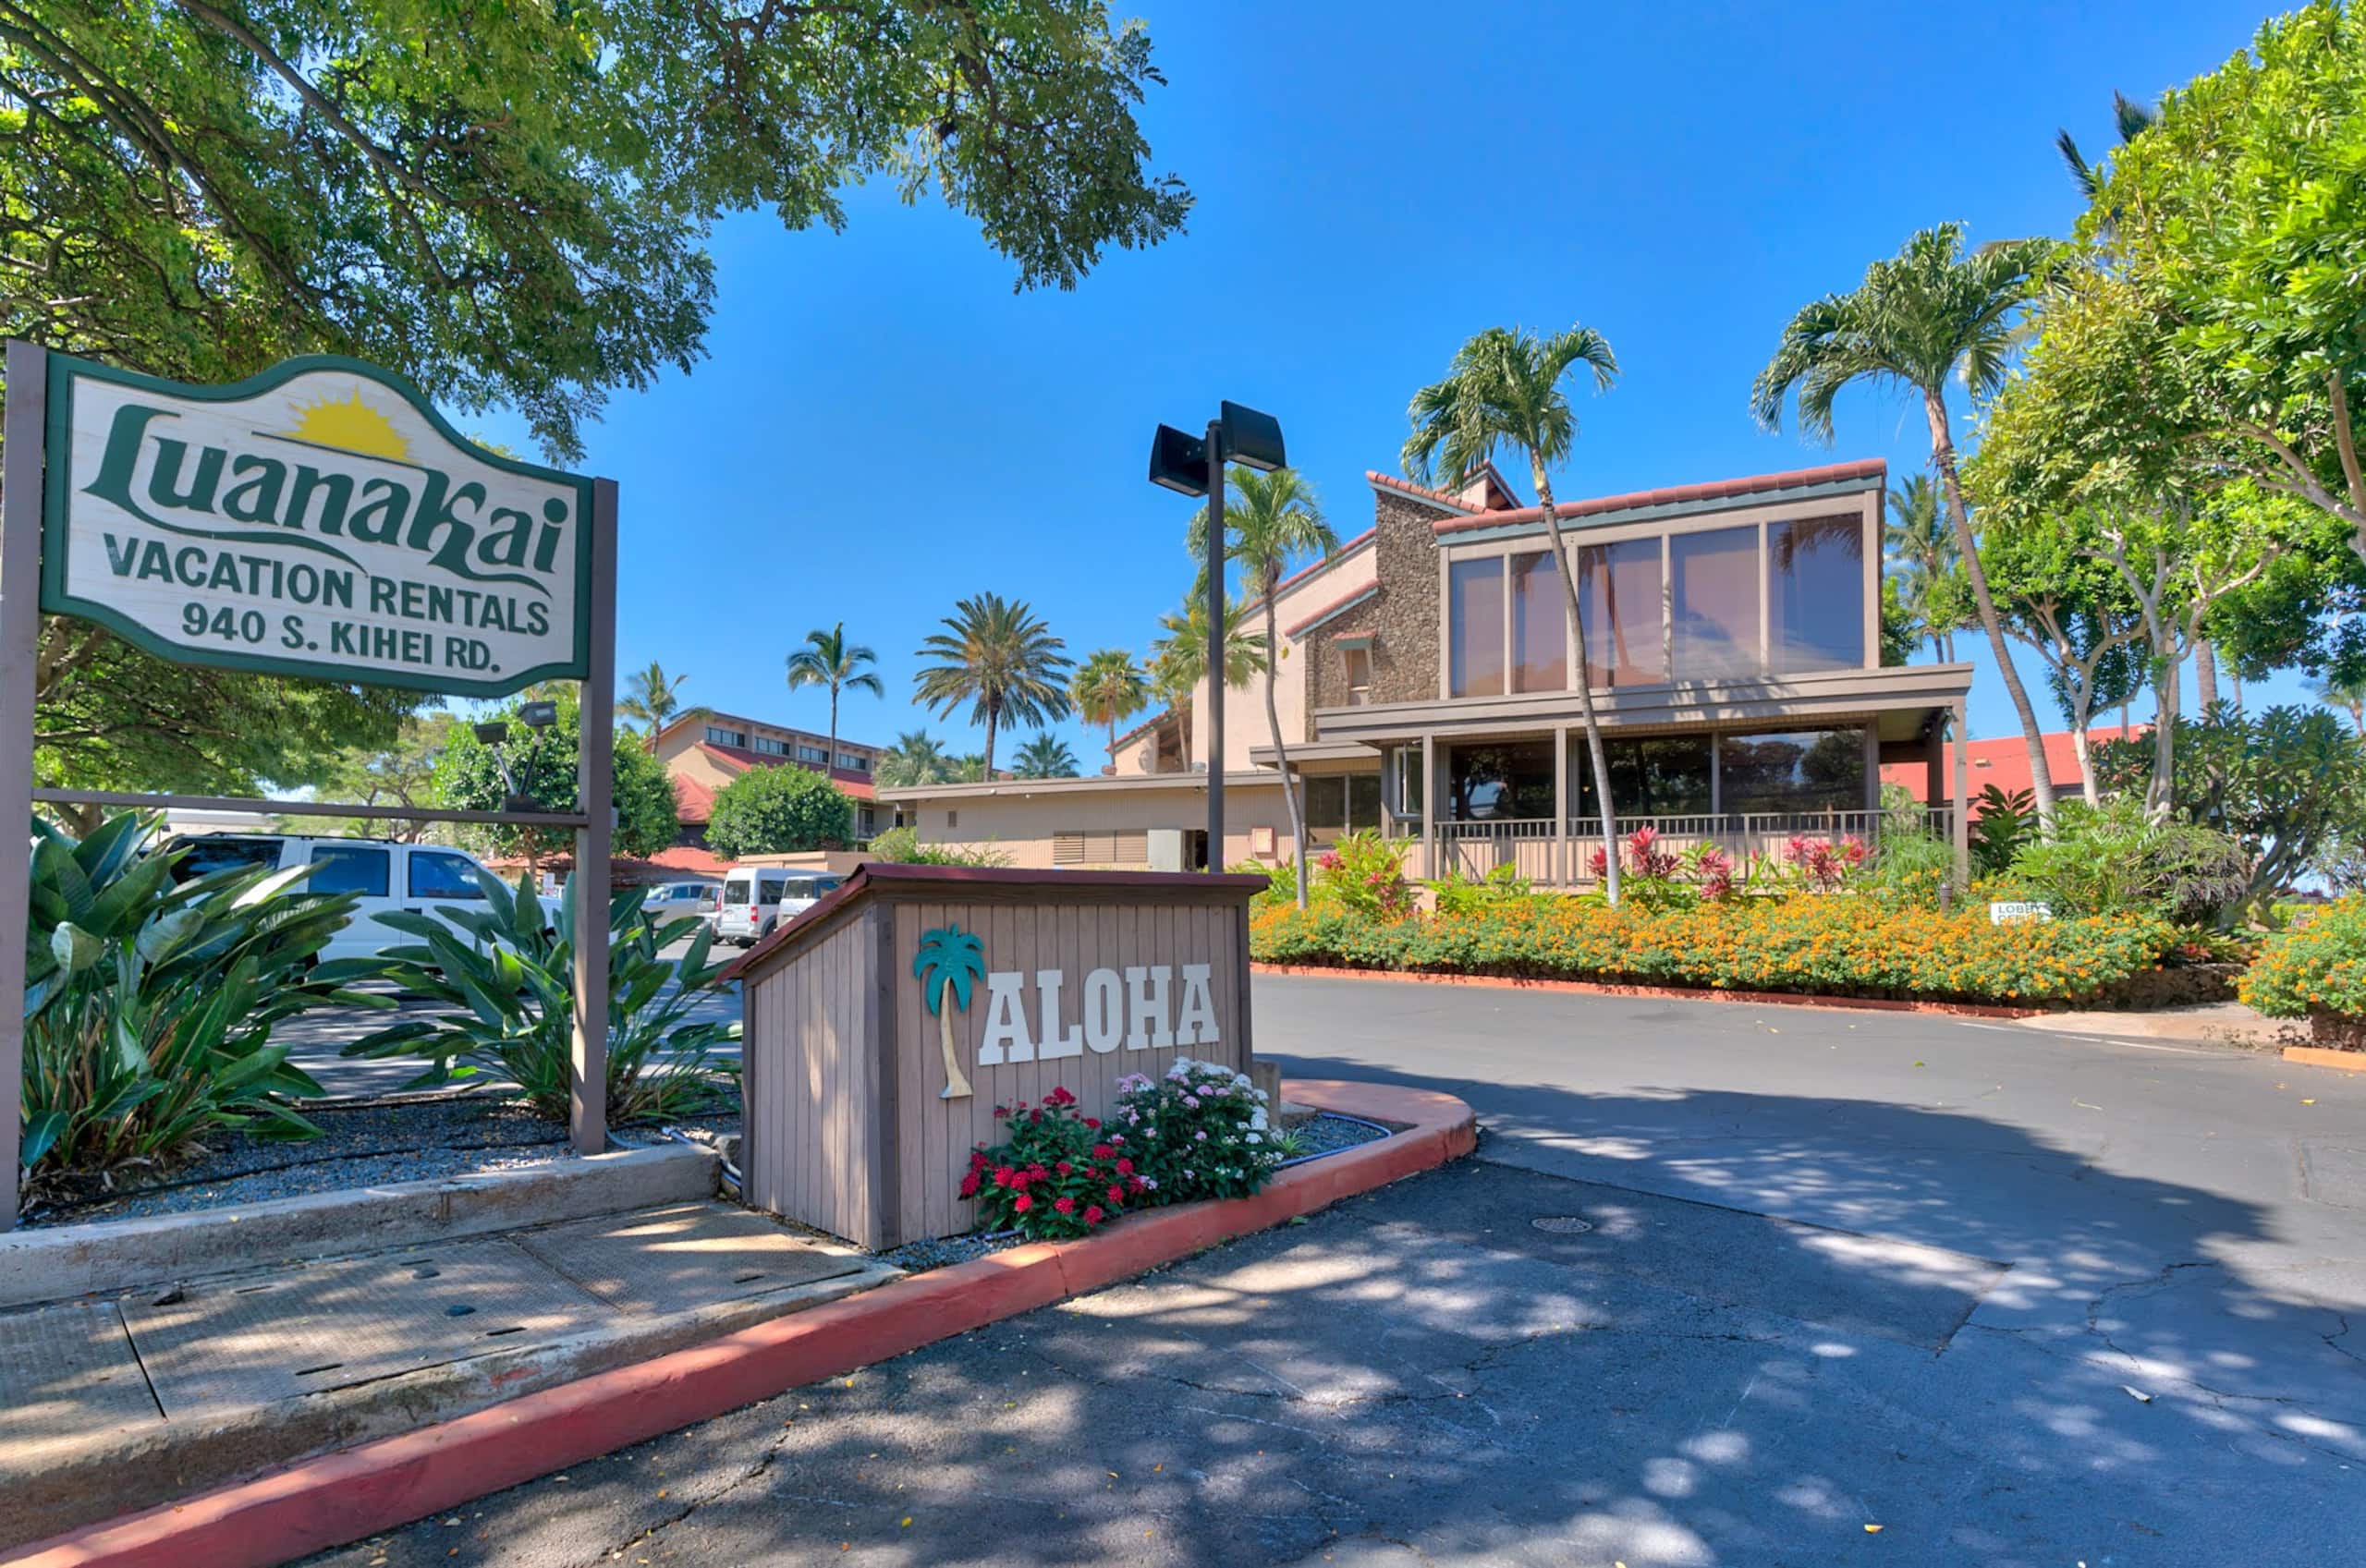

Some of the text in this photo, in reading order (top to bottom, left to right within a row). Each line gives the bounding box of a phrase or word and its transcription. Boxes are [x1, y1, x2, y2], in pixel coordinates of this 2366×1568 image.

[104, 533, 551, 637] VACATION RENTALS
[182, 602, 500, 674] 940 S. KIHEI RD.
[979, 964, 1220, 1066] ALOHA
